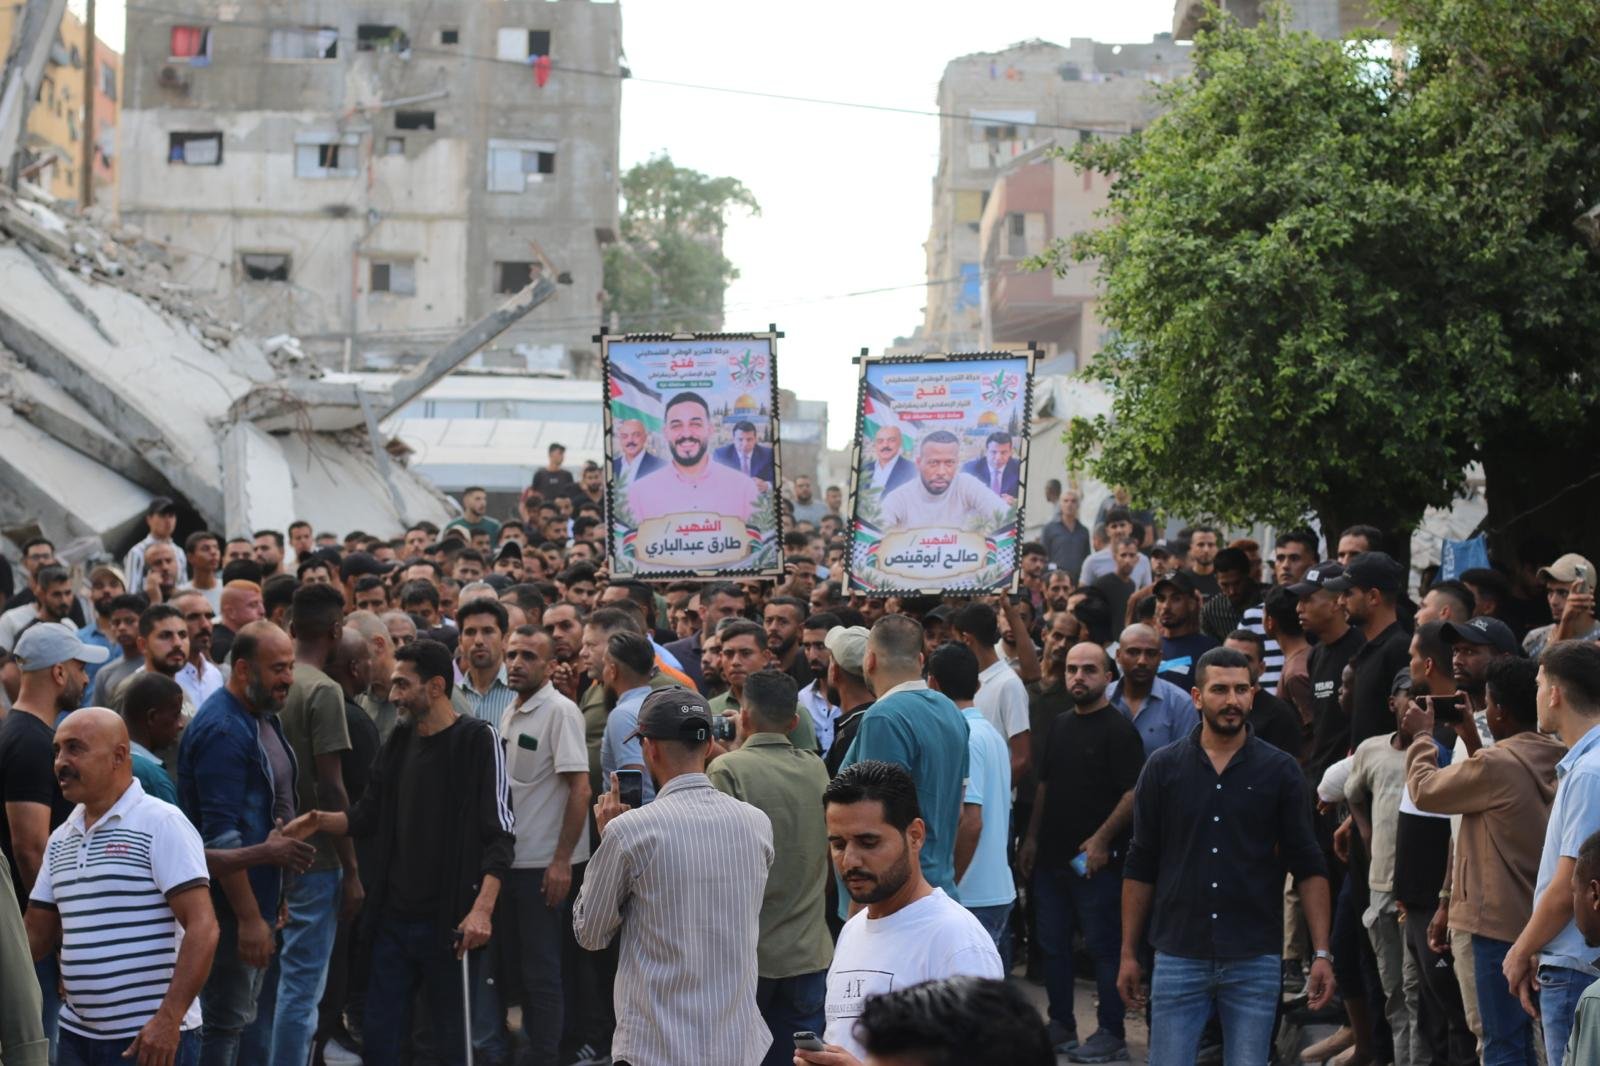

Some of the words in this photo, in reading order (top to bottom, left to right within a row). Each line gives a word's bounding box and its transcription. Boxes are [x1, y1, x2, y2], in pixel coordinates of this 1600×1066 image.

[670, 358, 694, 371] فتح
[916, 385, 946, 399] فتح
[676, 519, 721, 536] الشهيد
[645, 538, 704, 558] عبدالباري
[707, 536, 742, 554] طارق
[919, 534, 957, 548] الشهيد
[884, 547, 941, 568] أبوقينص
[943, 549, 978, 569] صالح
